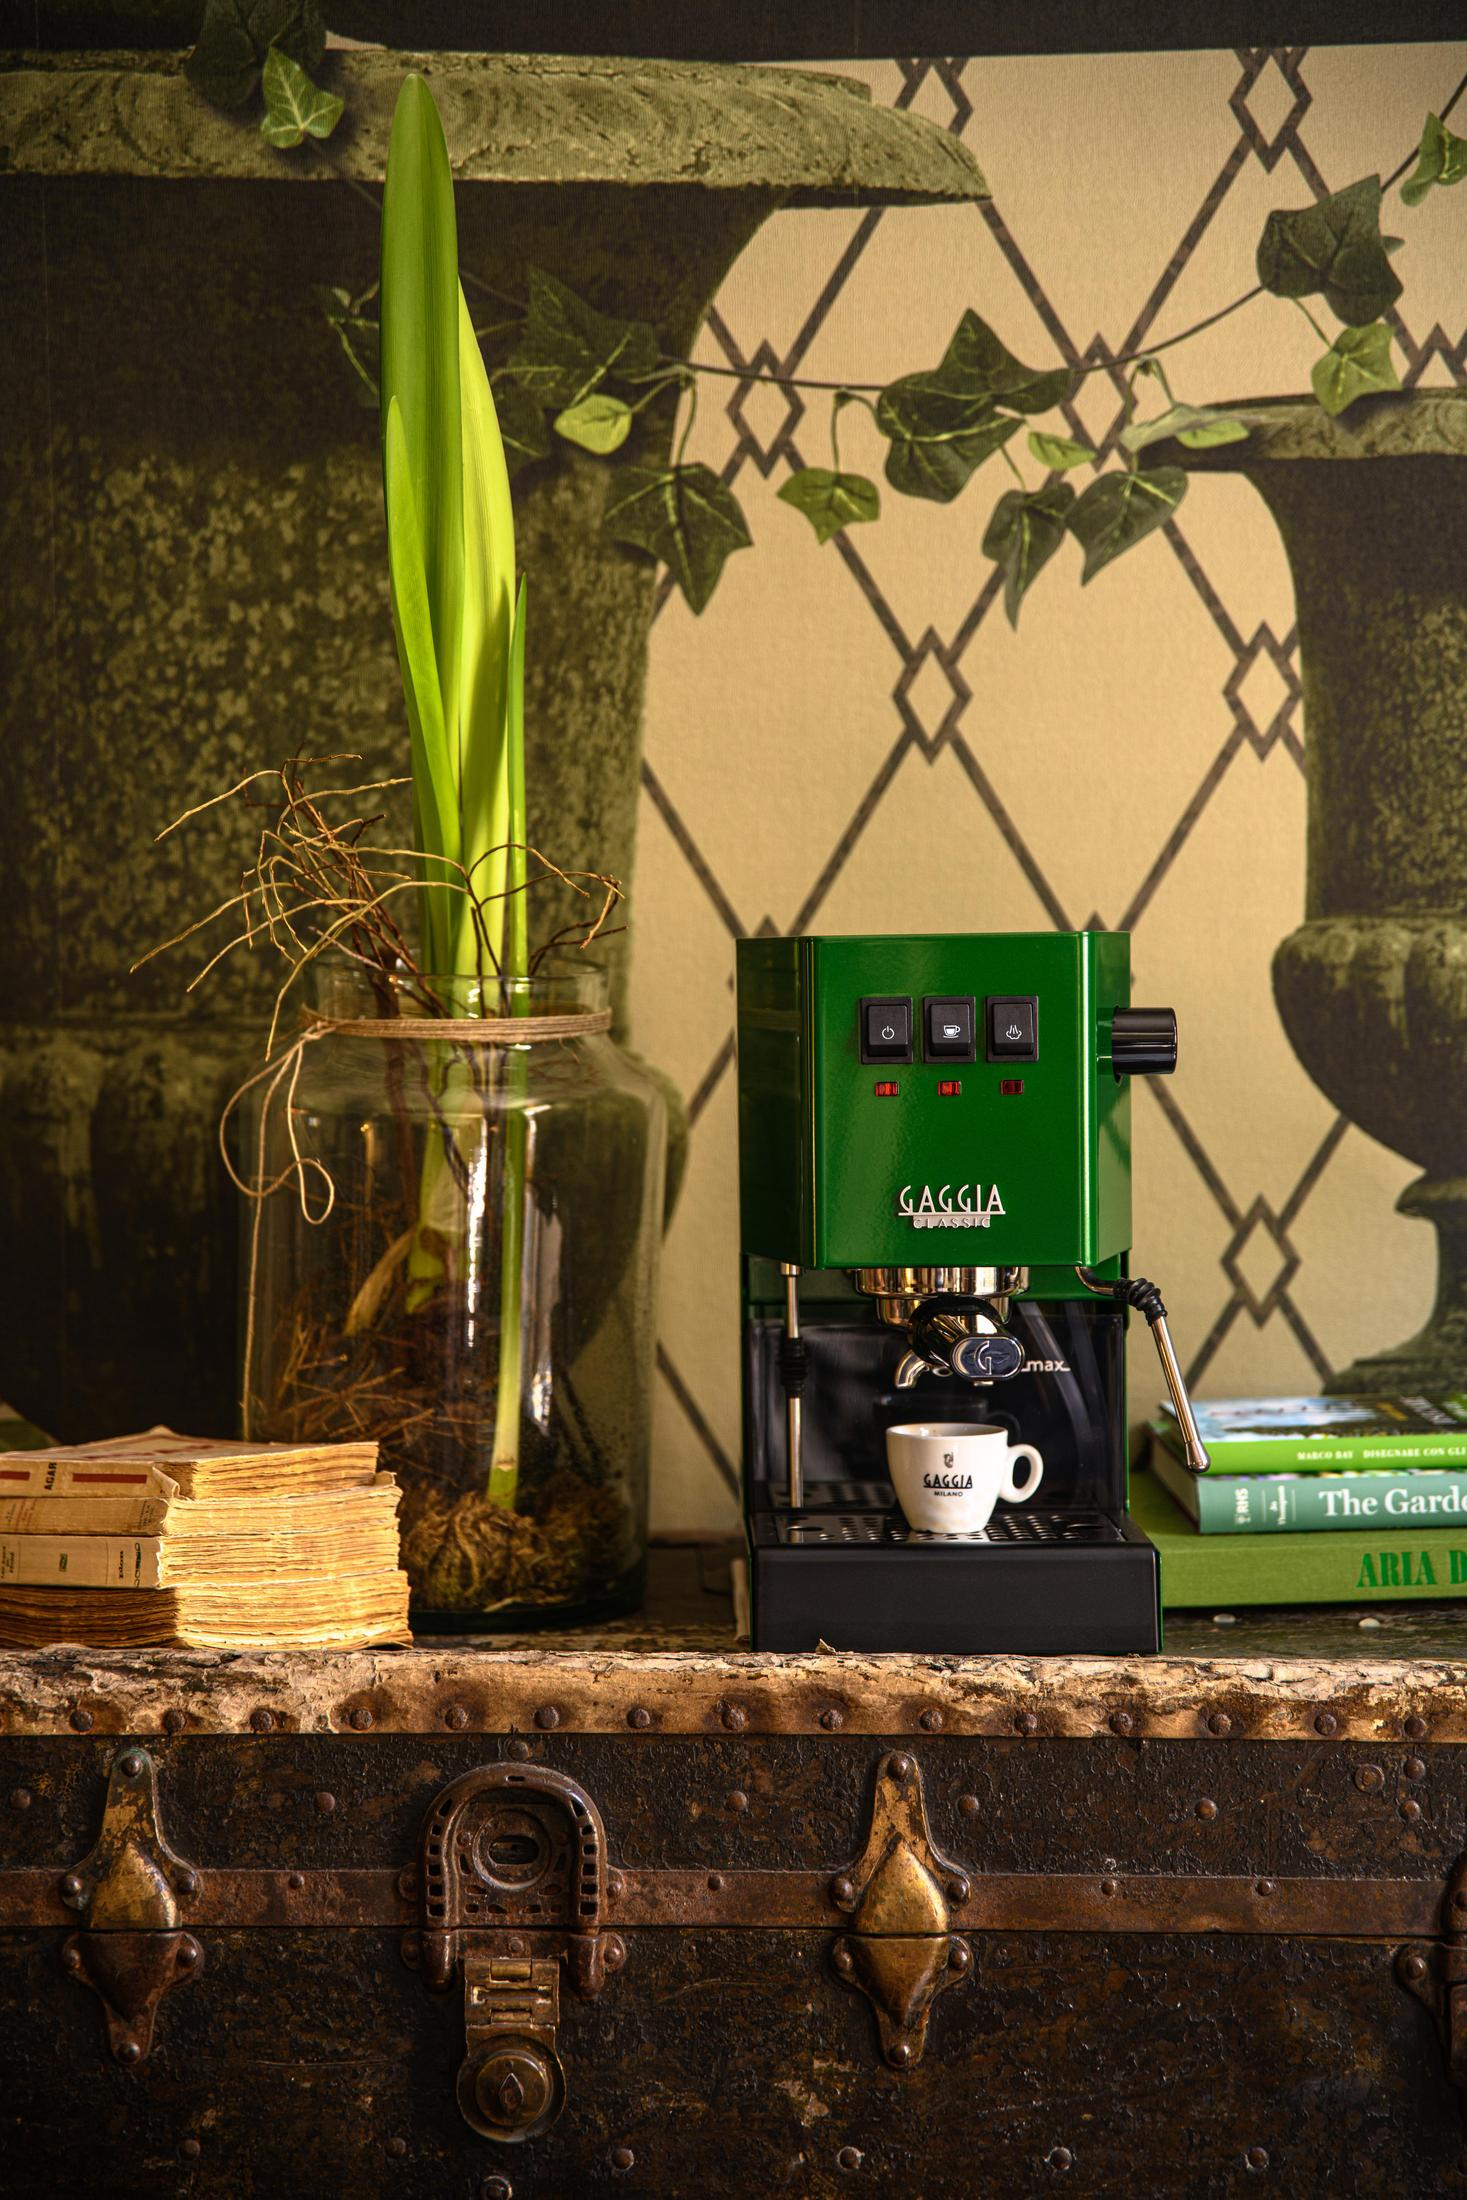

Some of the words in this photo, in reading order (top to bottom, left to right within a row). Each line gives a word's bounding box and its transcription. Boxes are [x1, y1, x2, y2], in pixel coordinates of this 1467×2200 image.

[899, 1184, 1005, 1214] GAGGIA
[913, 1216, 990, 1229] CLASSIC
[1028, 1359, 1064, 1371] max
[1297, 1450, 1332, 1460] MARCO
[1363, 1448, 1420, 1458] DISEGNARE
[1423, 1447, 1445, 1457] CON
[1448, 1446, 1466, 1456] GLI
[923, 1473, 973, 1489] GAGGIA
[1235, 1487, 1249, 1513] RHS
[1318, 1488, 1378, 1517] The
[1355, 1551, 1438, 1588] ARIA
